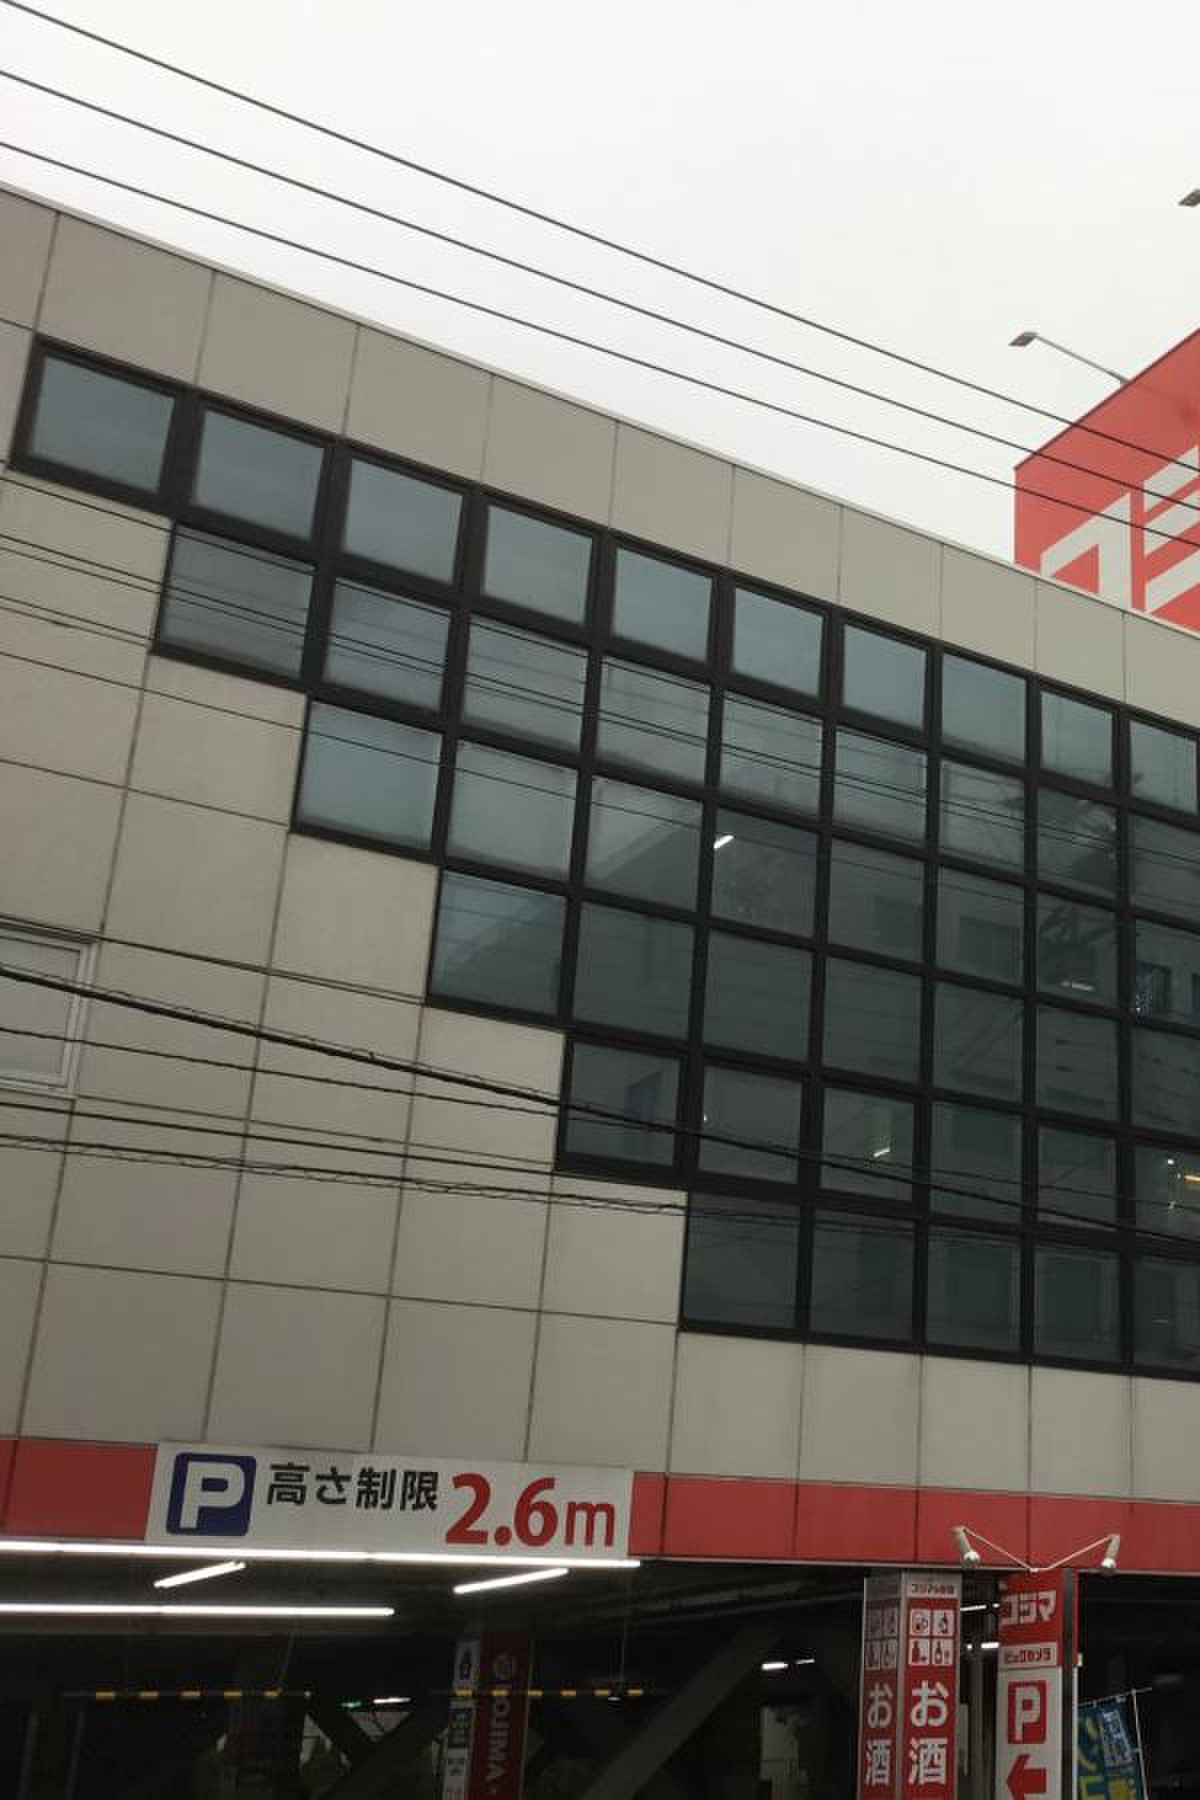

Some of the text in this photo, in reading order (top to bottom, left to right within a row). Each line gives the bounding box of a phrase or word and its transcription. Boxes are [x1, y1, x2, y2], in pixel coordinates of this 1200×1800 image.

[179, 1460, 246, 1528] P
[266, 1461, 616, 1547] 高さ制限 2.6m
[998, 1589, 1057, 1626] コジマ
[485, 1684, 512, 1783] OJIMA
[864, 1682, 894, 1787] お酒
[908, 1679, 950, 1785] お酒
[1014, 1685, 1041, 1742] P
